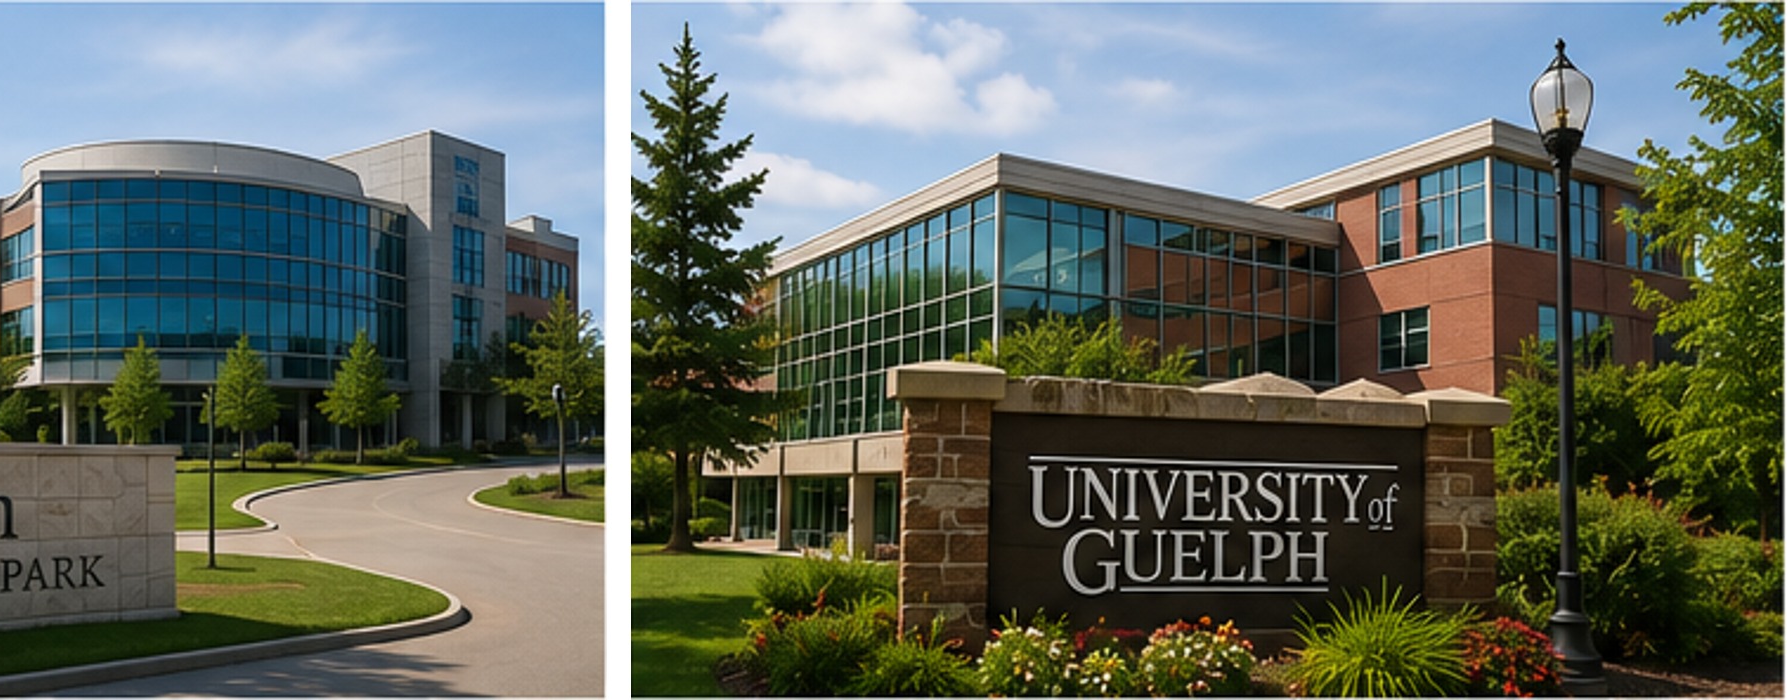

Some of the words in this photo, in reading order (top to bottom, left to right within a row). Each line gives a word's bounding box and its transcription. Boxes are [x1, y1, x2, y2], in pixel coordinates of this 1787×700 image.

[1028, 465, 1368, 528] UNIVERSITY
[1368, 483, 1400, 523] of
[0, 555, 105, 593] PARK
[1062, 528, 1328, 595] GUELPH
